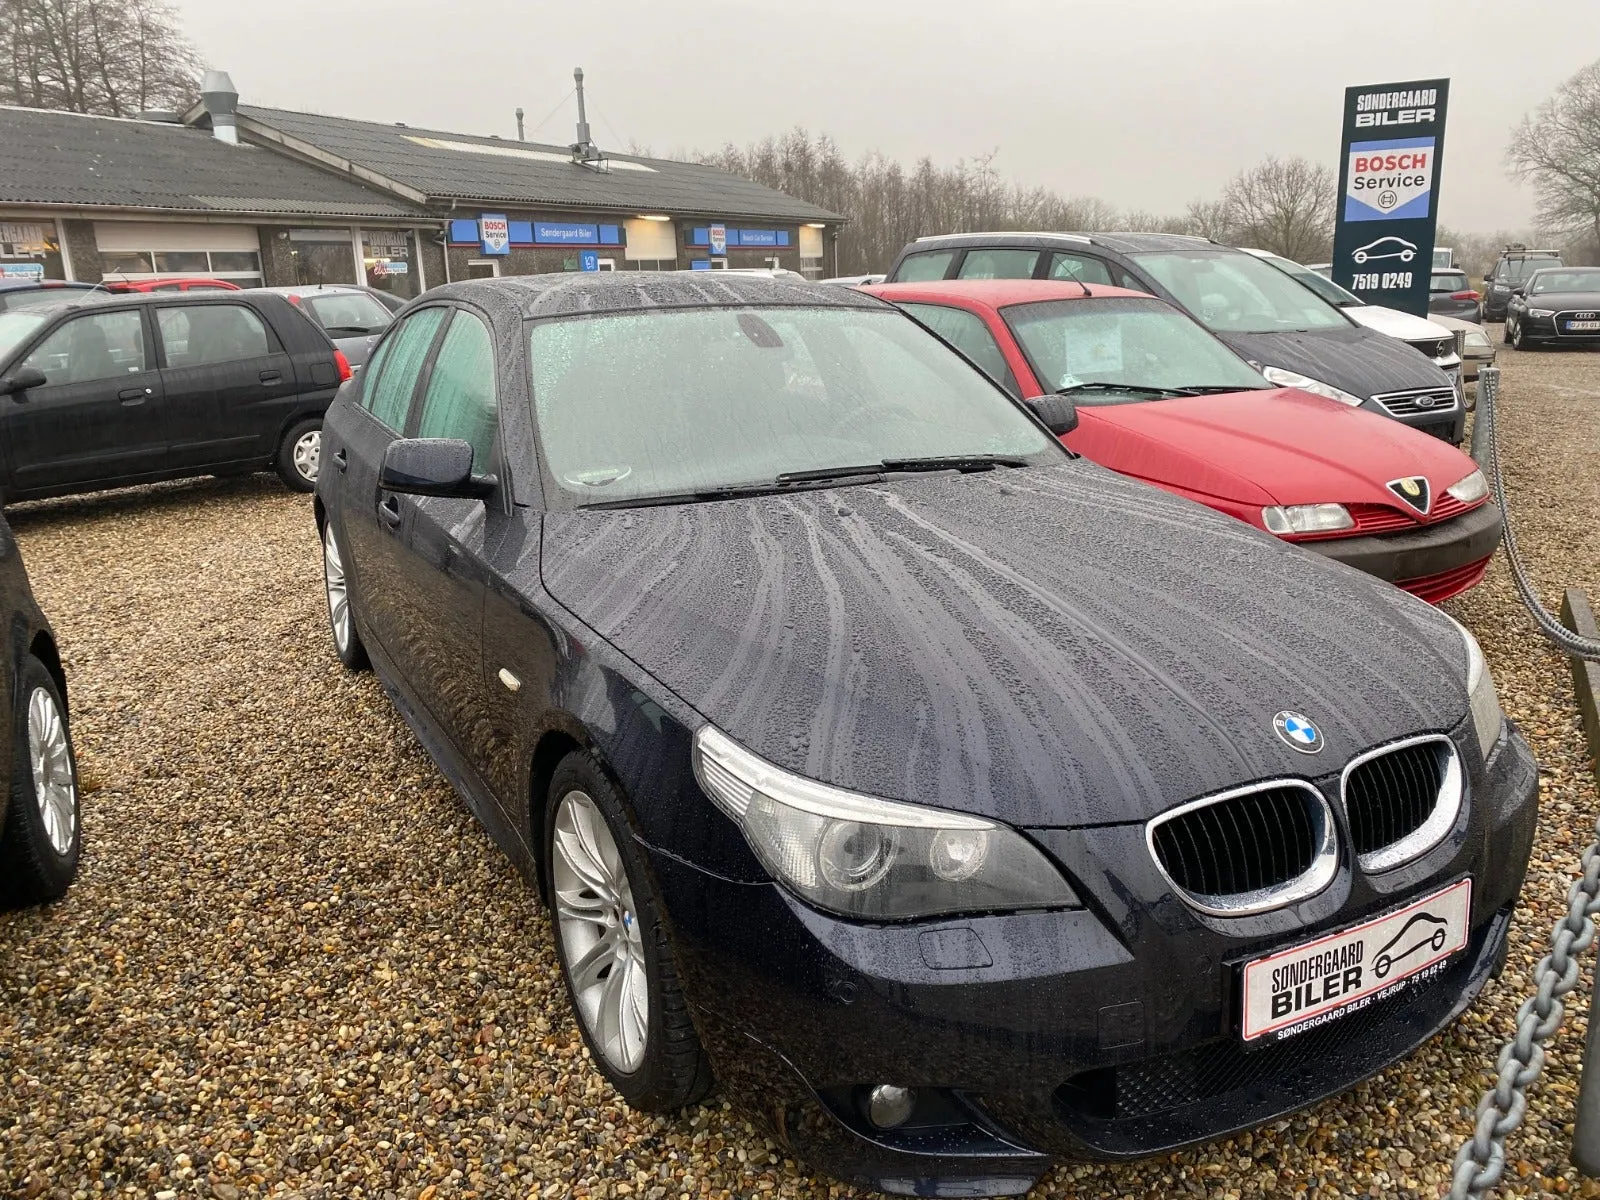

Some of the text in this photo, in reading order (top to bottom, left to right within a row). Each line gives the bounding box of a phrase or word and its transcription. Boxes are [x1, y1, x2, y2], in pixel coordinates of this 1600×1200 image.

[1357, 89, 1437, 112] SØNDERGAARD
[1355, 108, 1436, 128] BILER
[1355, 153, 1427, 173] BOSCH
[1353, 173, 1425, 190] Service
[484, 221, 506, 230] BOSCH
[485, 231, 507, 239] Service
[579, 228, 592, 238] Biler
[371, 246, 409, 258] BILER
[1352, 272, 1413, 290] 7519 0249
[1271, 940, 1364, 994] SØNDERGAARD
[1271, 965, 1362, 1020] BILER
[1277, 1007, 1345, 1040] SØNDERGAARD
[1346, 997, 1371, 1014] BILER
[1377, 980, 1406, 1000] VEJRUP
